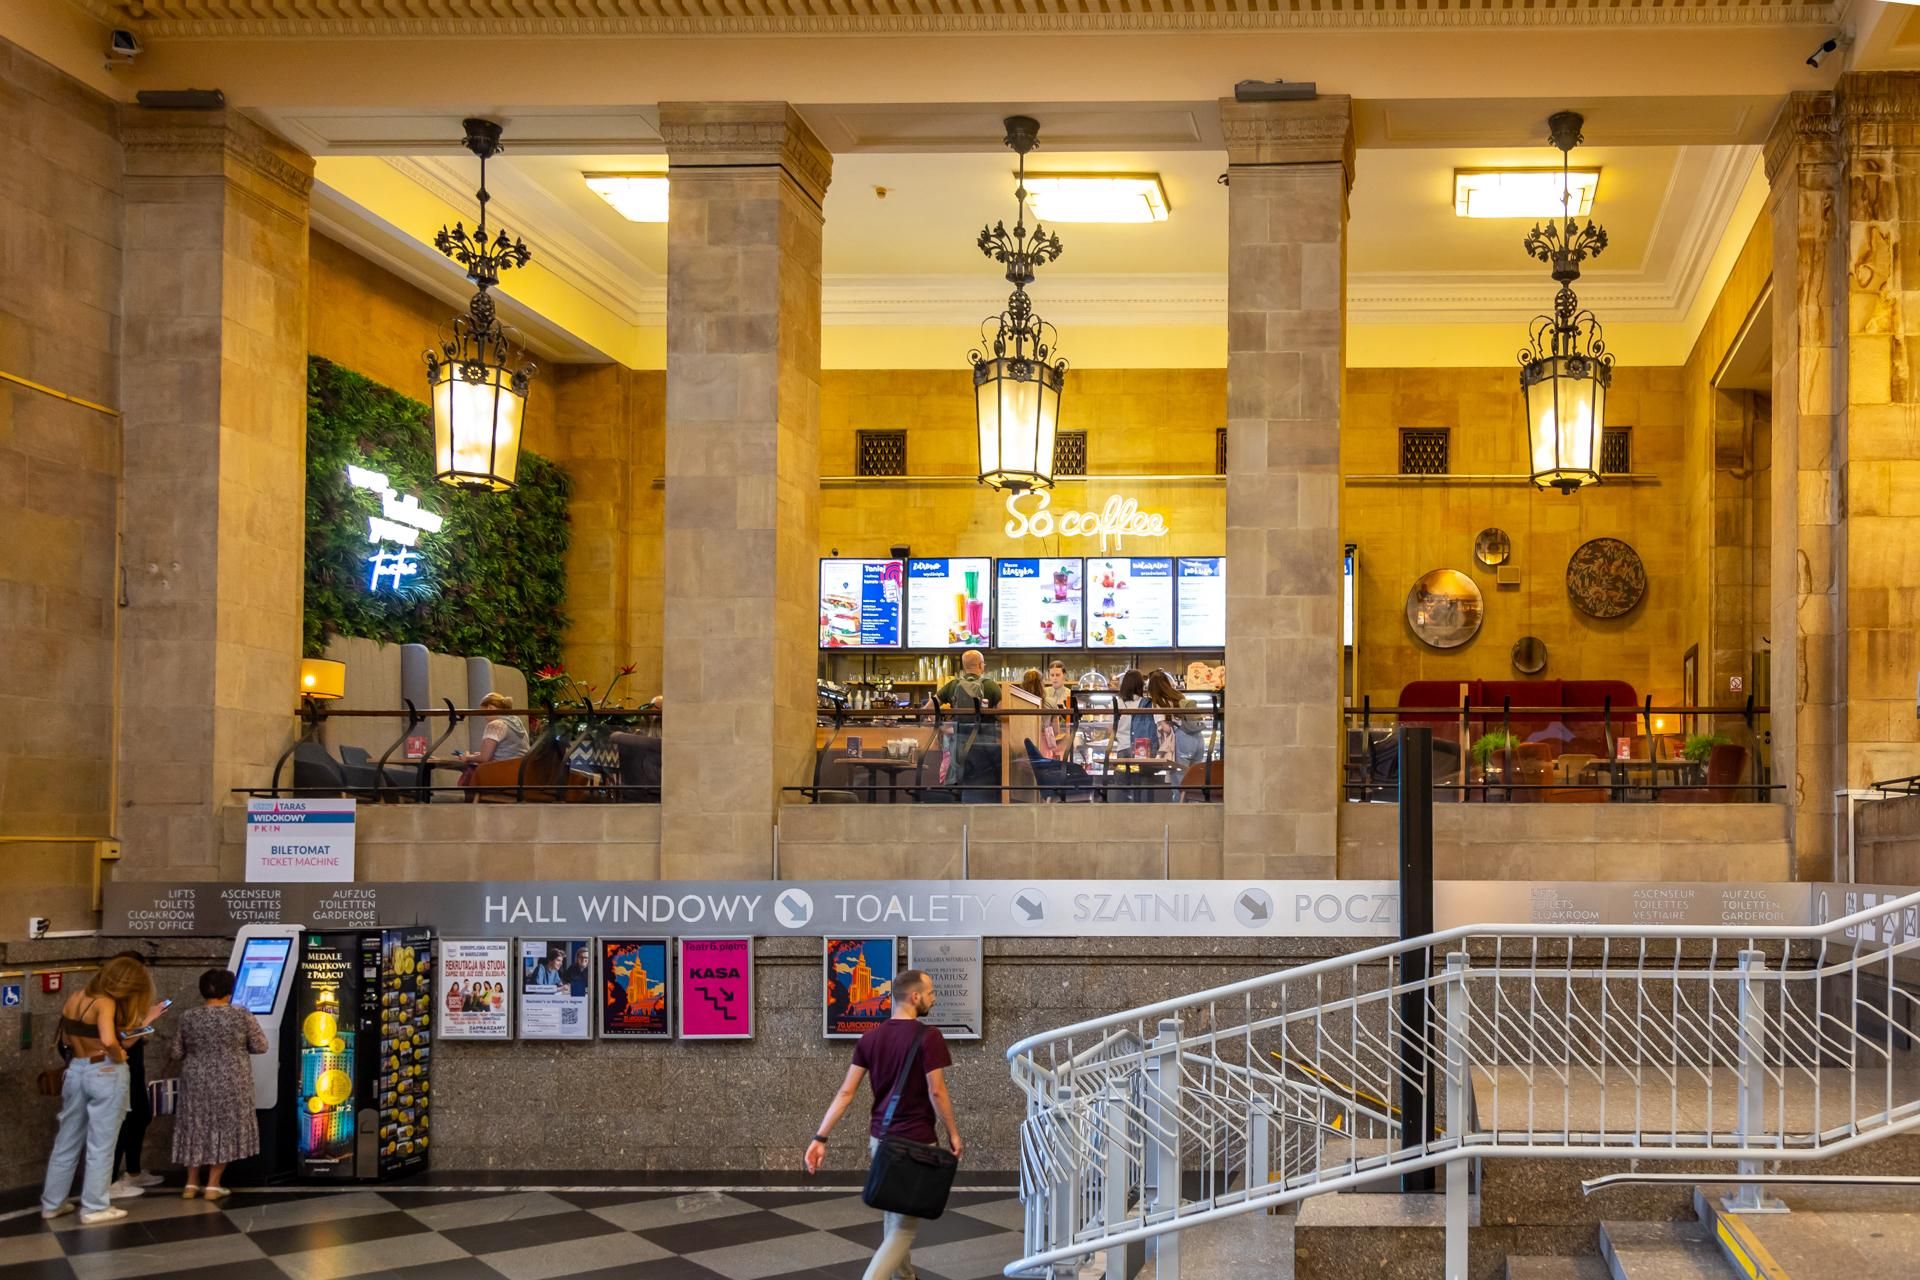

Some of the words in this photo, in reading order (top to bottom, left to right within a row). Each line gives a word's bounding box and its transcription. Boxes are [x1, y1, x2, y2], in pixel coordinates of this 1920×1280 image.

[1059, 494, 1168, 551] coffee
[280, 802, 306, 810] TARAS
[253, 814, 306, 822] WIDOKOWY
[271, 845, 330, 855] BILETOMAT
[262, 858, 293, 866] TICKET
[295, 858, 339, 866] MACHINE
[168, 889, 196, 899] LIFTS
[221, 889, 281, 899] ASCENSEUR
[333, 889, 376, 899] AUFZUG
[1633, 889, 1696, 898] ASCENSEUR
[1721, 890, 1766, 899] AUFZUG
[154, 900, 195, 909] TOILETS
[227, 900, 281, 910] TOILETTES
[320, 900, 376, 909] TOILETTEN
[484, 895, 567, 923] HALL
[578, 894, 762, 922] WINDOWY
[834, 894, 997, 922] TOALETY
[1072, 894, 1216, 922] SZATNIA
[1634, 900, 1689, 909] TOILETTES
[1722, 900, 1780, 910] TOILETTEN
[128, 910, 195, 920] CLOAKROOM
[229, 910, 281, 920] VESTIAIRE
[313, 910, 376, 920] GARDEROBE
[1632, 911, 1686, 920] VESTIAIRE
[129, 921, 154, 930] POST
[158, 921, 194, 930] OFFICE
[302, 962, 352, 971] PAMIĄTKOWE
[445, 960, 478, 970] REKRUTACJA
[480, 960, 485, 970] NA
[487, 960, 506, 970] STUDIA
[690, 968, 741, 979] KASA
